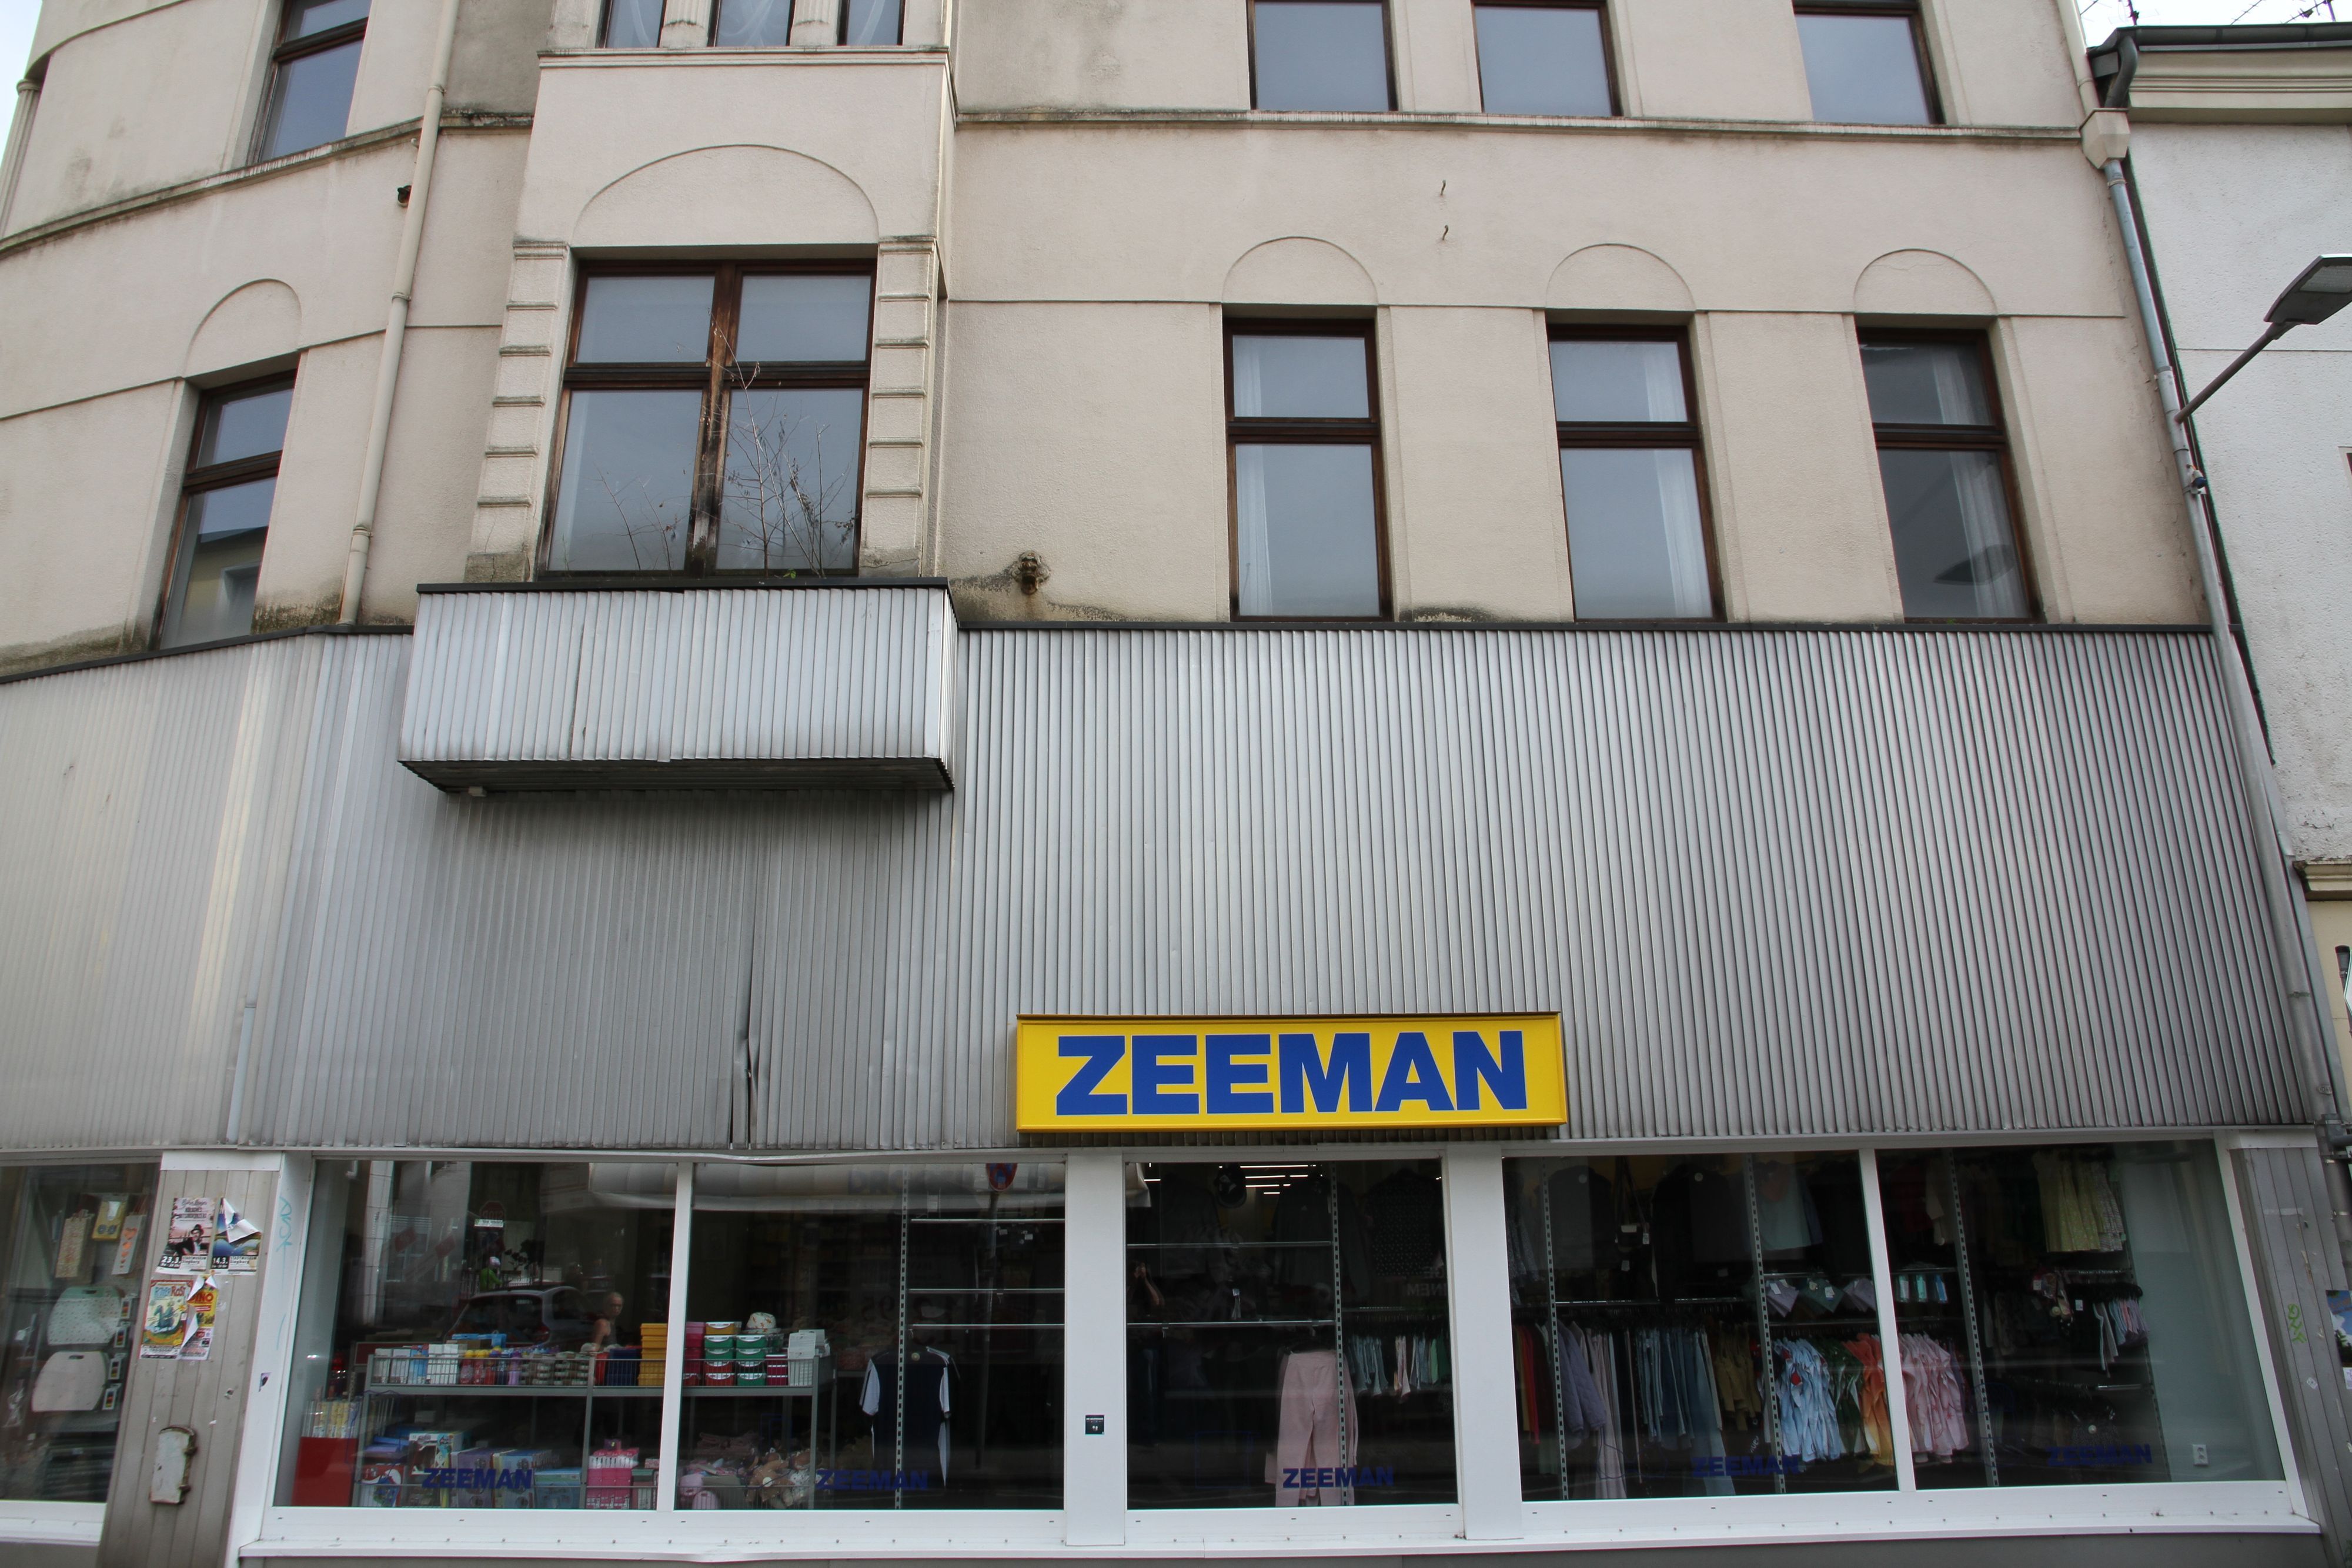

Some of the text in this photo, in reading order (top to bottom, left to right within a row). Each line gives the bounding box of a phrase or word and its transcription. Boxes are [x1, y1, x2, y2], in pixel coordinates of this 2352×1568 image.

[1056, 1030, 1528, 1116] ZEEMAN
[2047, 1443, 2152, 1467] ZEEMAN
[1692, 1455, 1800, 1477] ZEEMAN
[422, 1468, 533, 1489] ZEEMAN
[814, 1469, 928, 1490] ZEEMAN
[1282, 1467, 1394, 1488] ZEEMAN
